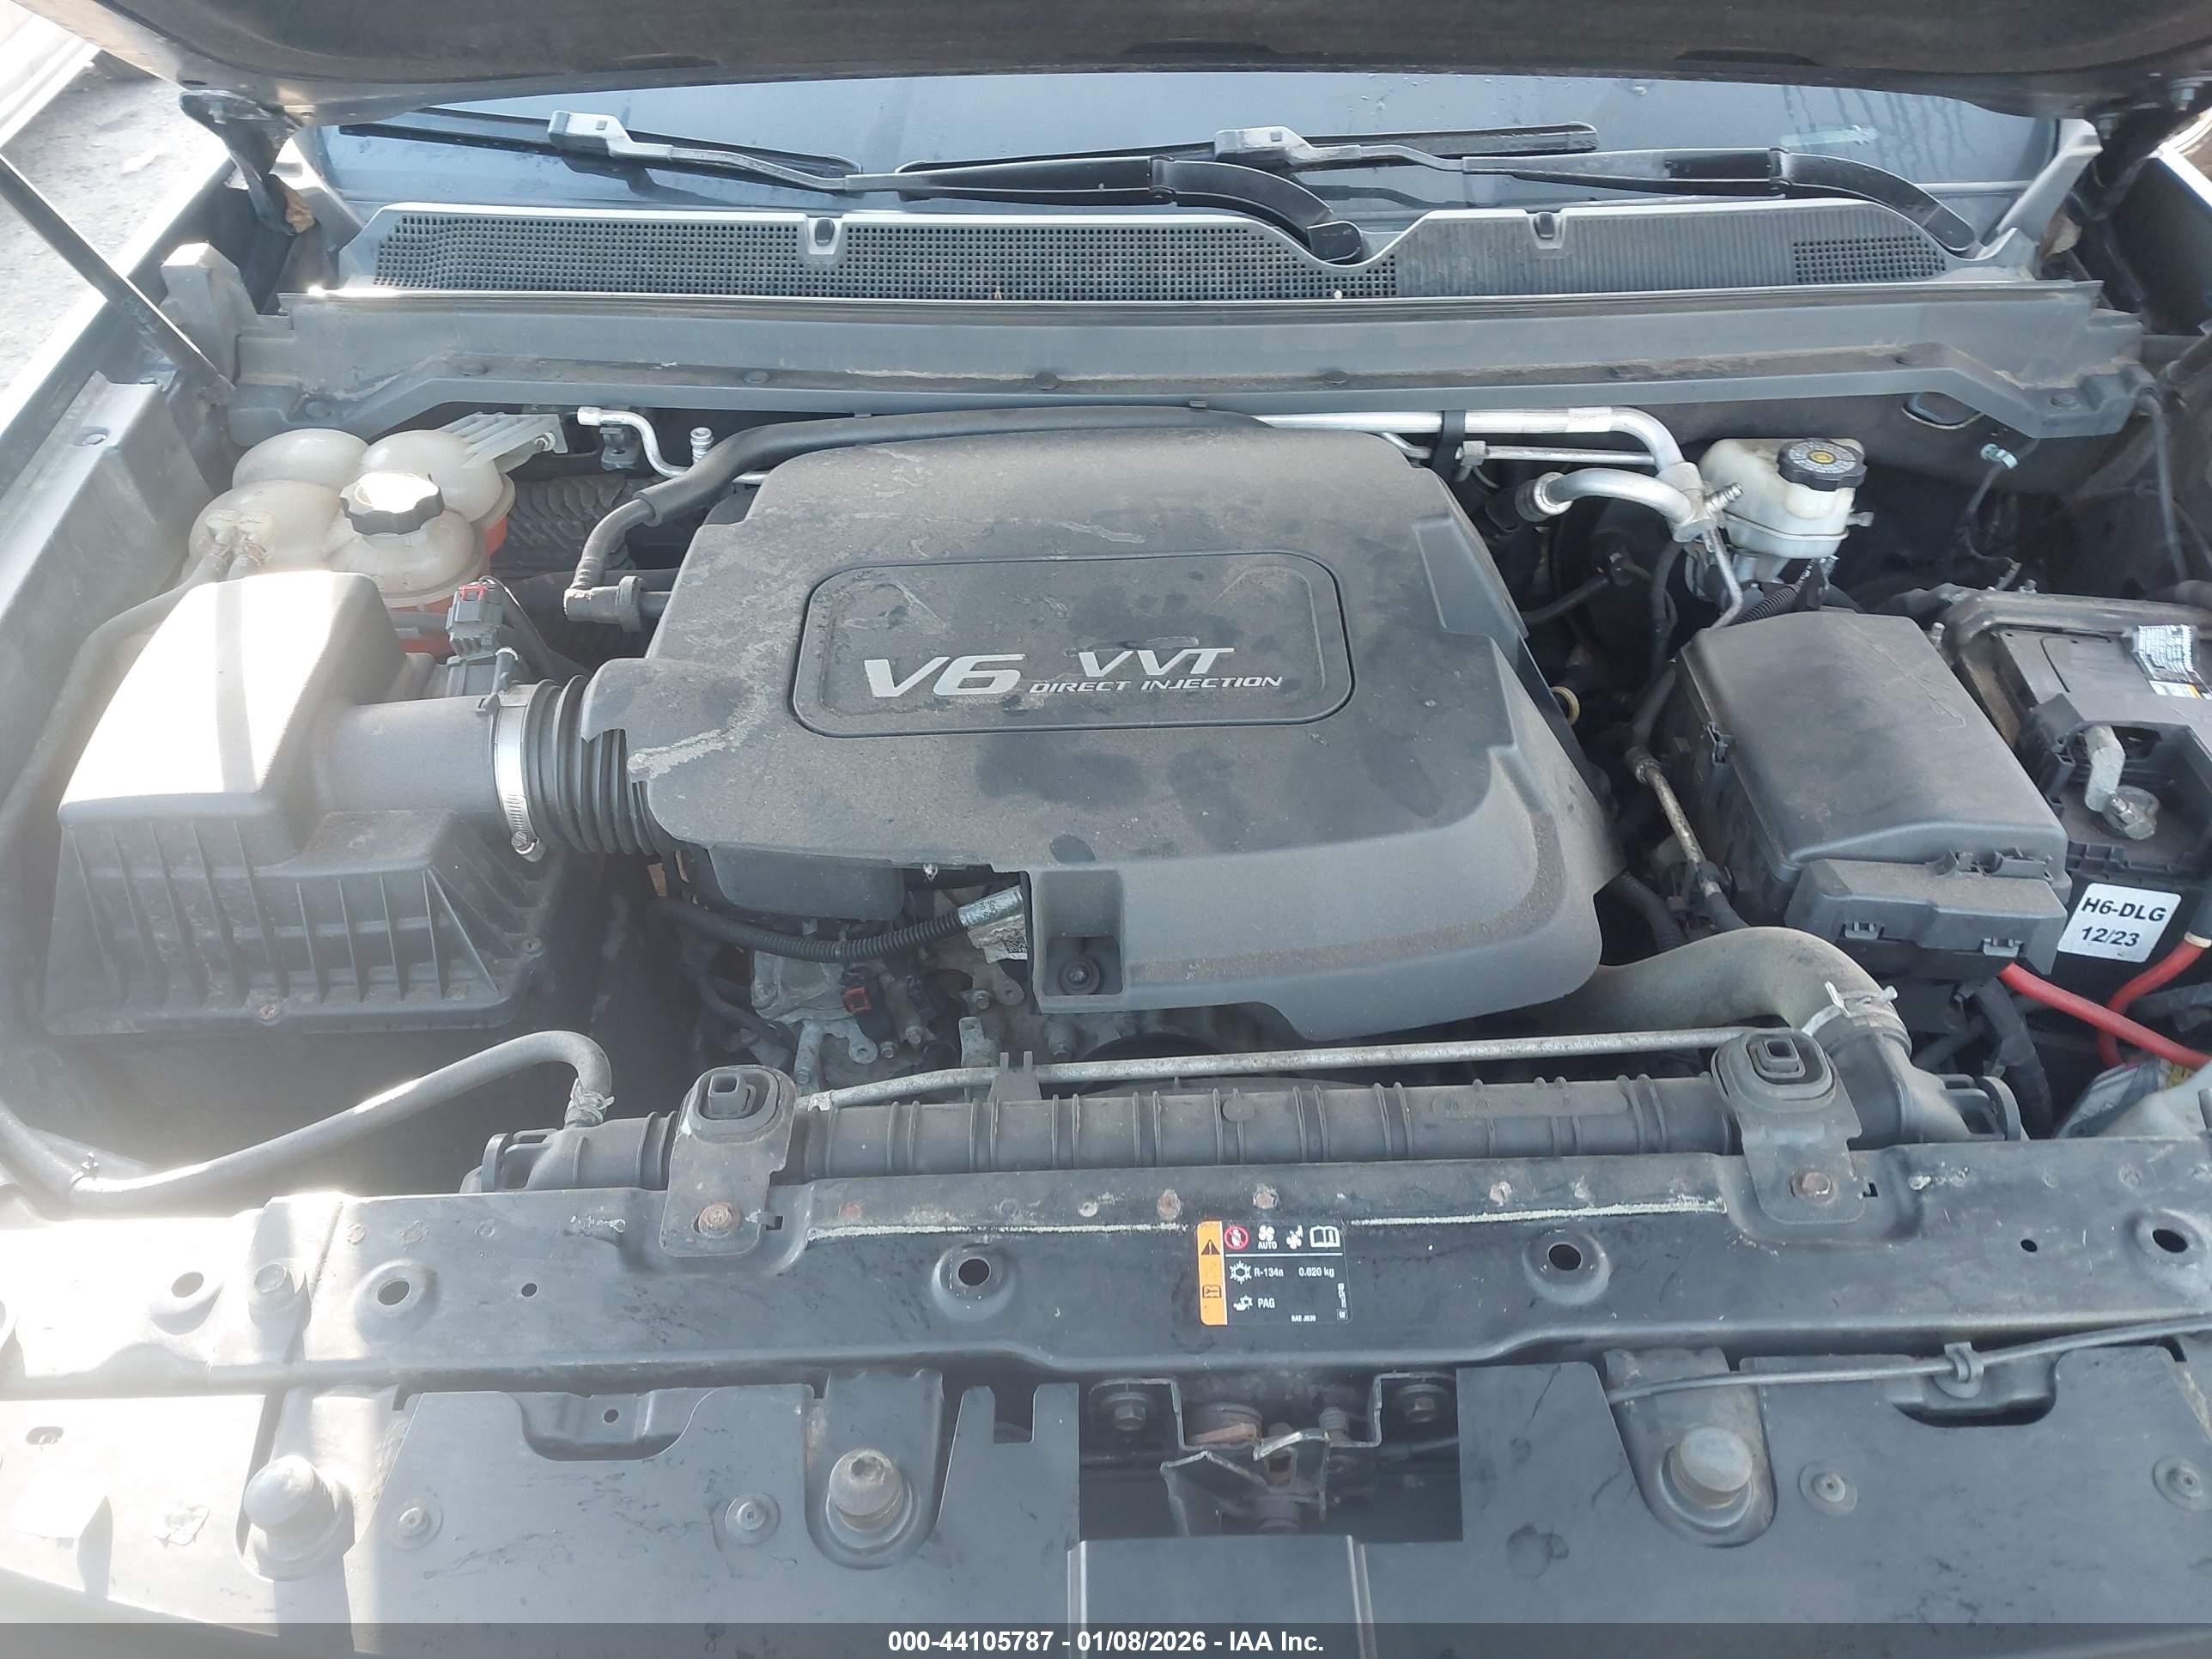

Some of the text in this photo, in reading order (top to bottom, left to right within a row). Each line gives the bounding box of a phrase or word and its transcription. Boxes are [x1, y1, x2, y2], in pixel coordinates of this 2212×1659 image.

[863, 647, 1237, 698] V6 VVT
[1028, 675, 1284, 695] DIRECT INJECTION
[2081, 897, 2167, 921] H6-DLG
[2081, 926, 2141, 947] 12/23
[1257, 1241, 1278, 1249] AUTO
[1324, 1267, 1335, 1279] kg
[1257, 1298, 1276, 1309] PAG
